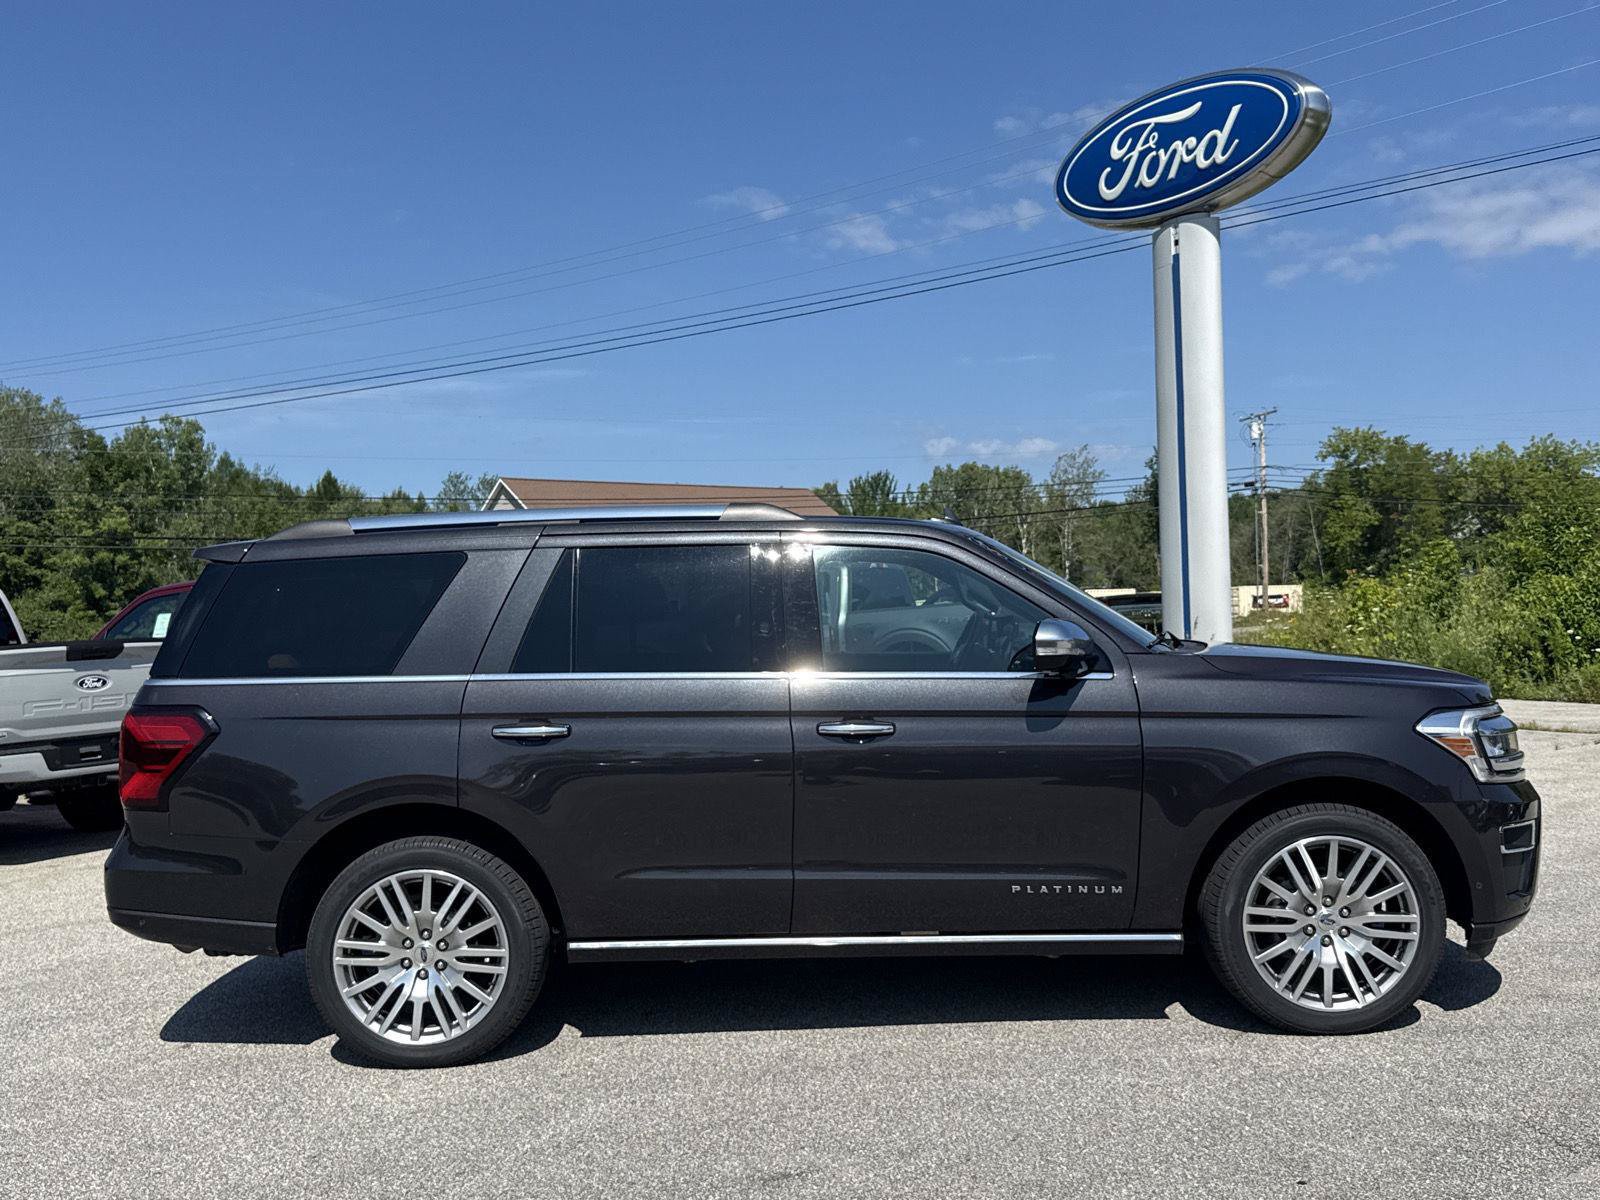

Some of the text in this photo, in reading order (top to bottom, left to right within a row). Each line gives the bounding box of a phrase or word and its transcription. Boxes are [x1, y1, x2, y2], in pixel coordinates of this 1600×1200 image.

[1098, 101, 1242, 201] Ford
[82, 677, 104, 688] Ford
[1011, 885, 1123, 894] PLATINUM
